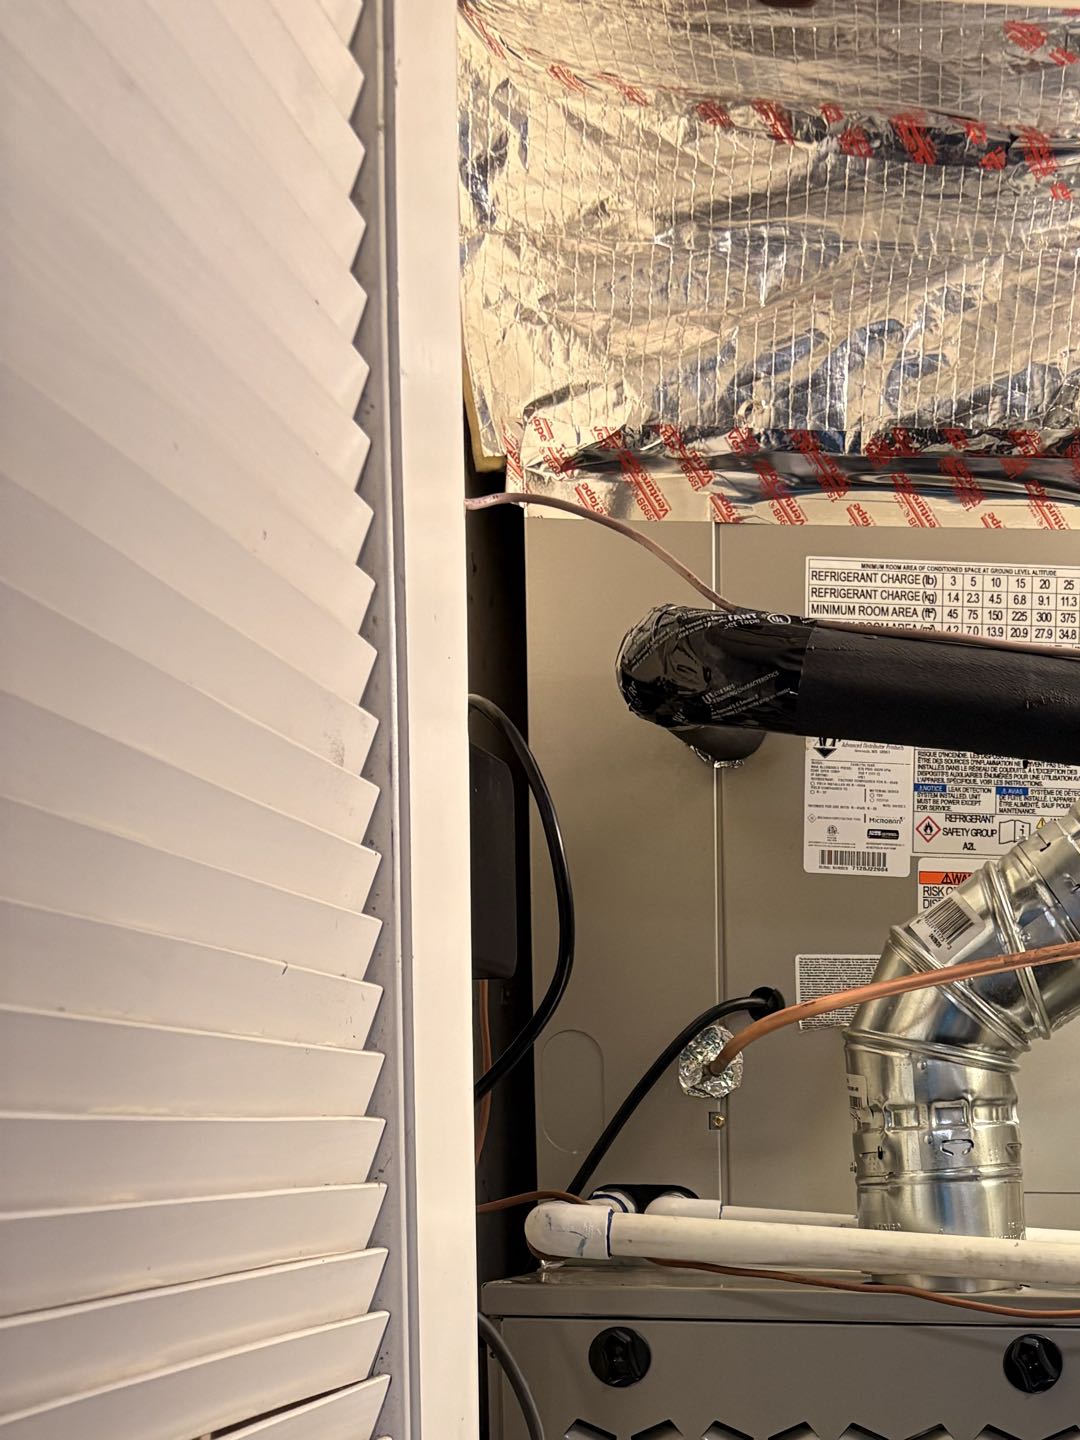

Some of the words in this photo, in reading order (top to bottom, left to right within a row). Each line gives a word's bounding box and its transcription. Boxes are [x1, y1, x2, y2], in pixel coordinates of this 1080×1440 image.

[927, 565, 962, 573] CONDITIONED
[811, 570, 878, 583] REFRIGERANT
[880, 573, 920, 585] CHARGE
[922, 574, 938, 588] (lb)
[950, 576, 956, 586] 3
[970, 577, 976, 587] 5
[992, 578, 1001, 588] 10
[1016, 578, 1026, 589] 15
[1040, 579, 1050, 590] 20
[1064, 580, 1075, 590] 25
[811, 587, 878, 600] REFRIGERANT
[880, 590, 920, 602] CHARGE
[922, 592, 937, 604] (kg)
[948, 592, 960, 603] 1.4
[967, 593, 980, 604] 2.3
[988, 594, 1002, 605] 4.5
[1014, 594, 1027, 605] 6.8
[1038, 595, 1050, 606] 9.1
[1061, 596, 1077, 607] 11.3
[811, 604, 856, 616] MINIMUM
[858, 605, 888, 617] ROOM
[891, 606, 918, 618] AREA
[947, 609, 958, 619] 45
[968, 610, 978, 620] 75
[988, 610, 1003, 621] 150
[1012, 611, 1027, 622] 225
[1036, 612, 1052, 622] 300
[1060, 613, 1076, 623] 375
[986, 626, 1004, 638] 13.9
[1010, 628, 1028, 638] 20.9
[1035, 629, 1053, 639] 27.9
[1059, 629, 1077, 640] 34.8
[944, 814, 995, 824] REFRIGERANT
[942, 828, 969, 836] SAFETY
[971, 829, 997, 837] GROUP
[962, 842, 976, 850] A2L
[923, 886, 945, 896] RISK
